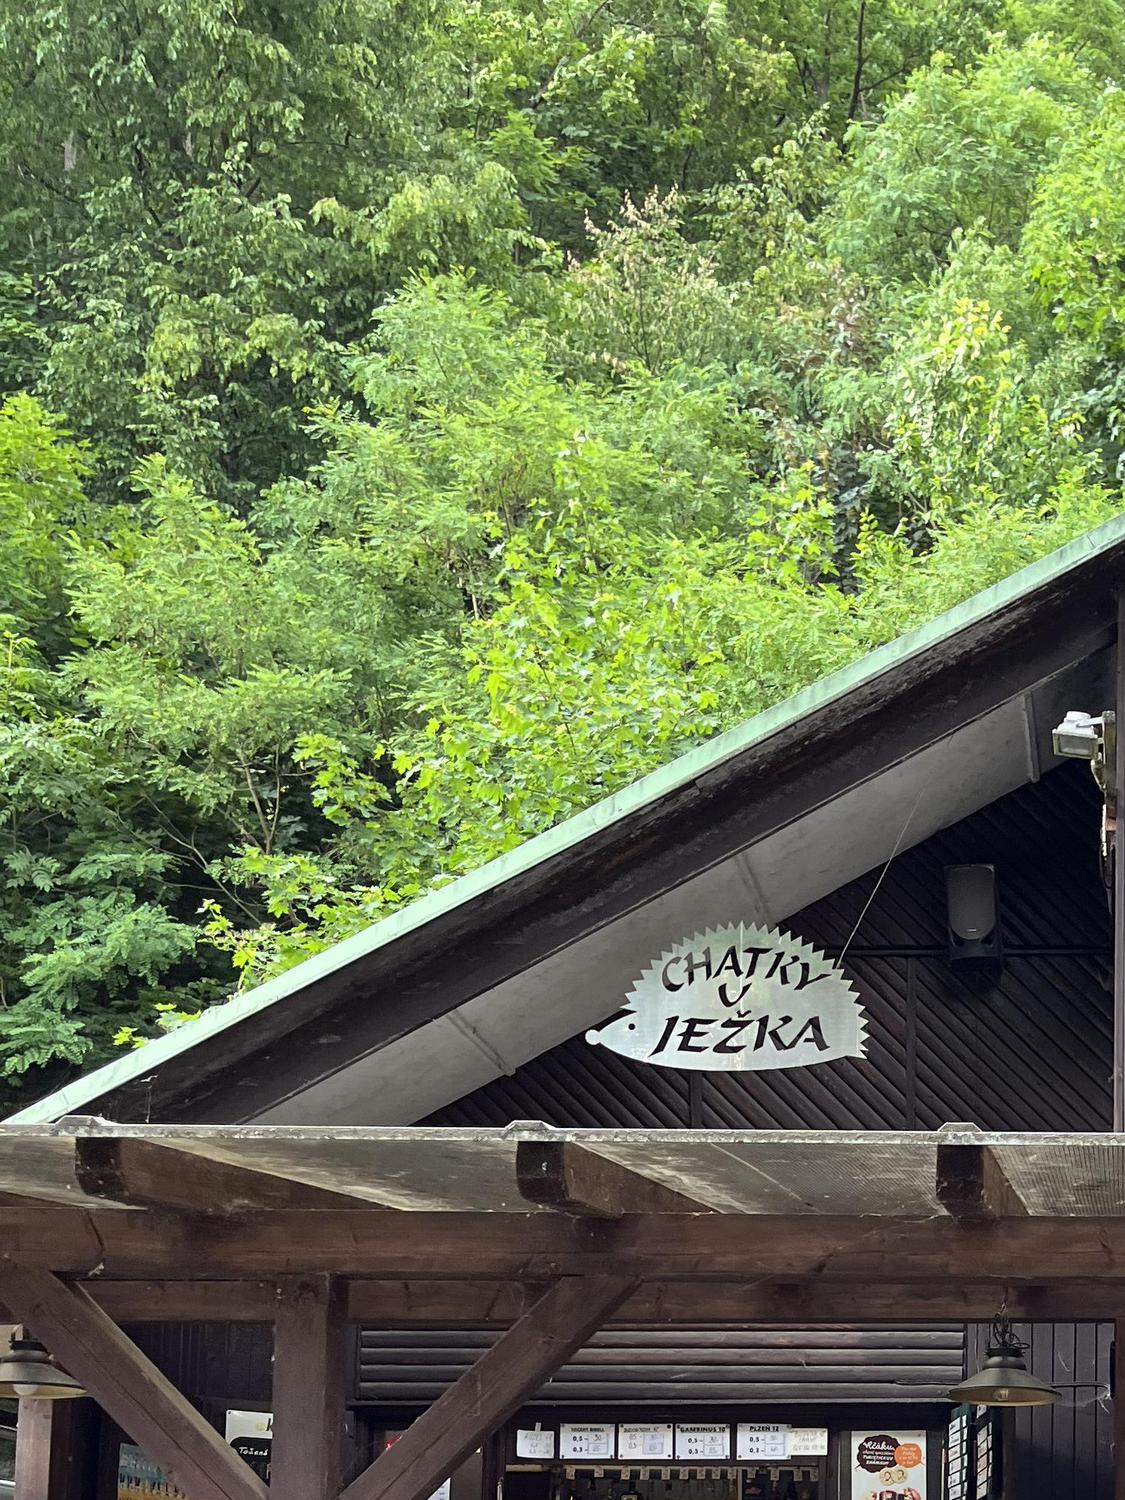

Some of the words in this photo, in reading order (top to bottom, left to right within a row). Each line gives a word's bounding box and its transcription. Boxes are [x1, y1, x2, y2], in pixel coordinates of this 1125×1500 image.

[661, 945, 832, 992] CHATKY
[718, 982, 752, 1008] U
[648, 1010, 831, 1058] JEŽKA
